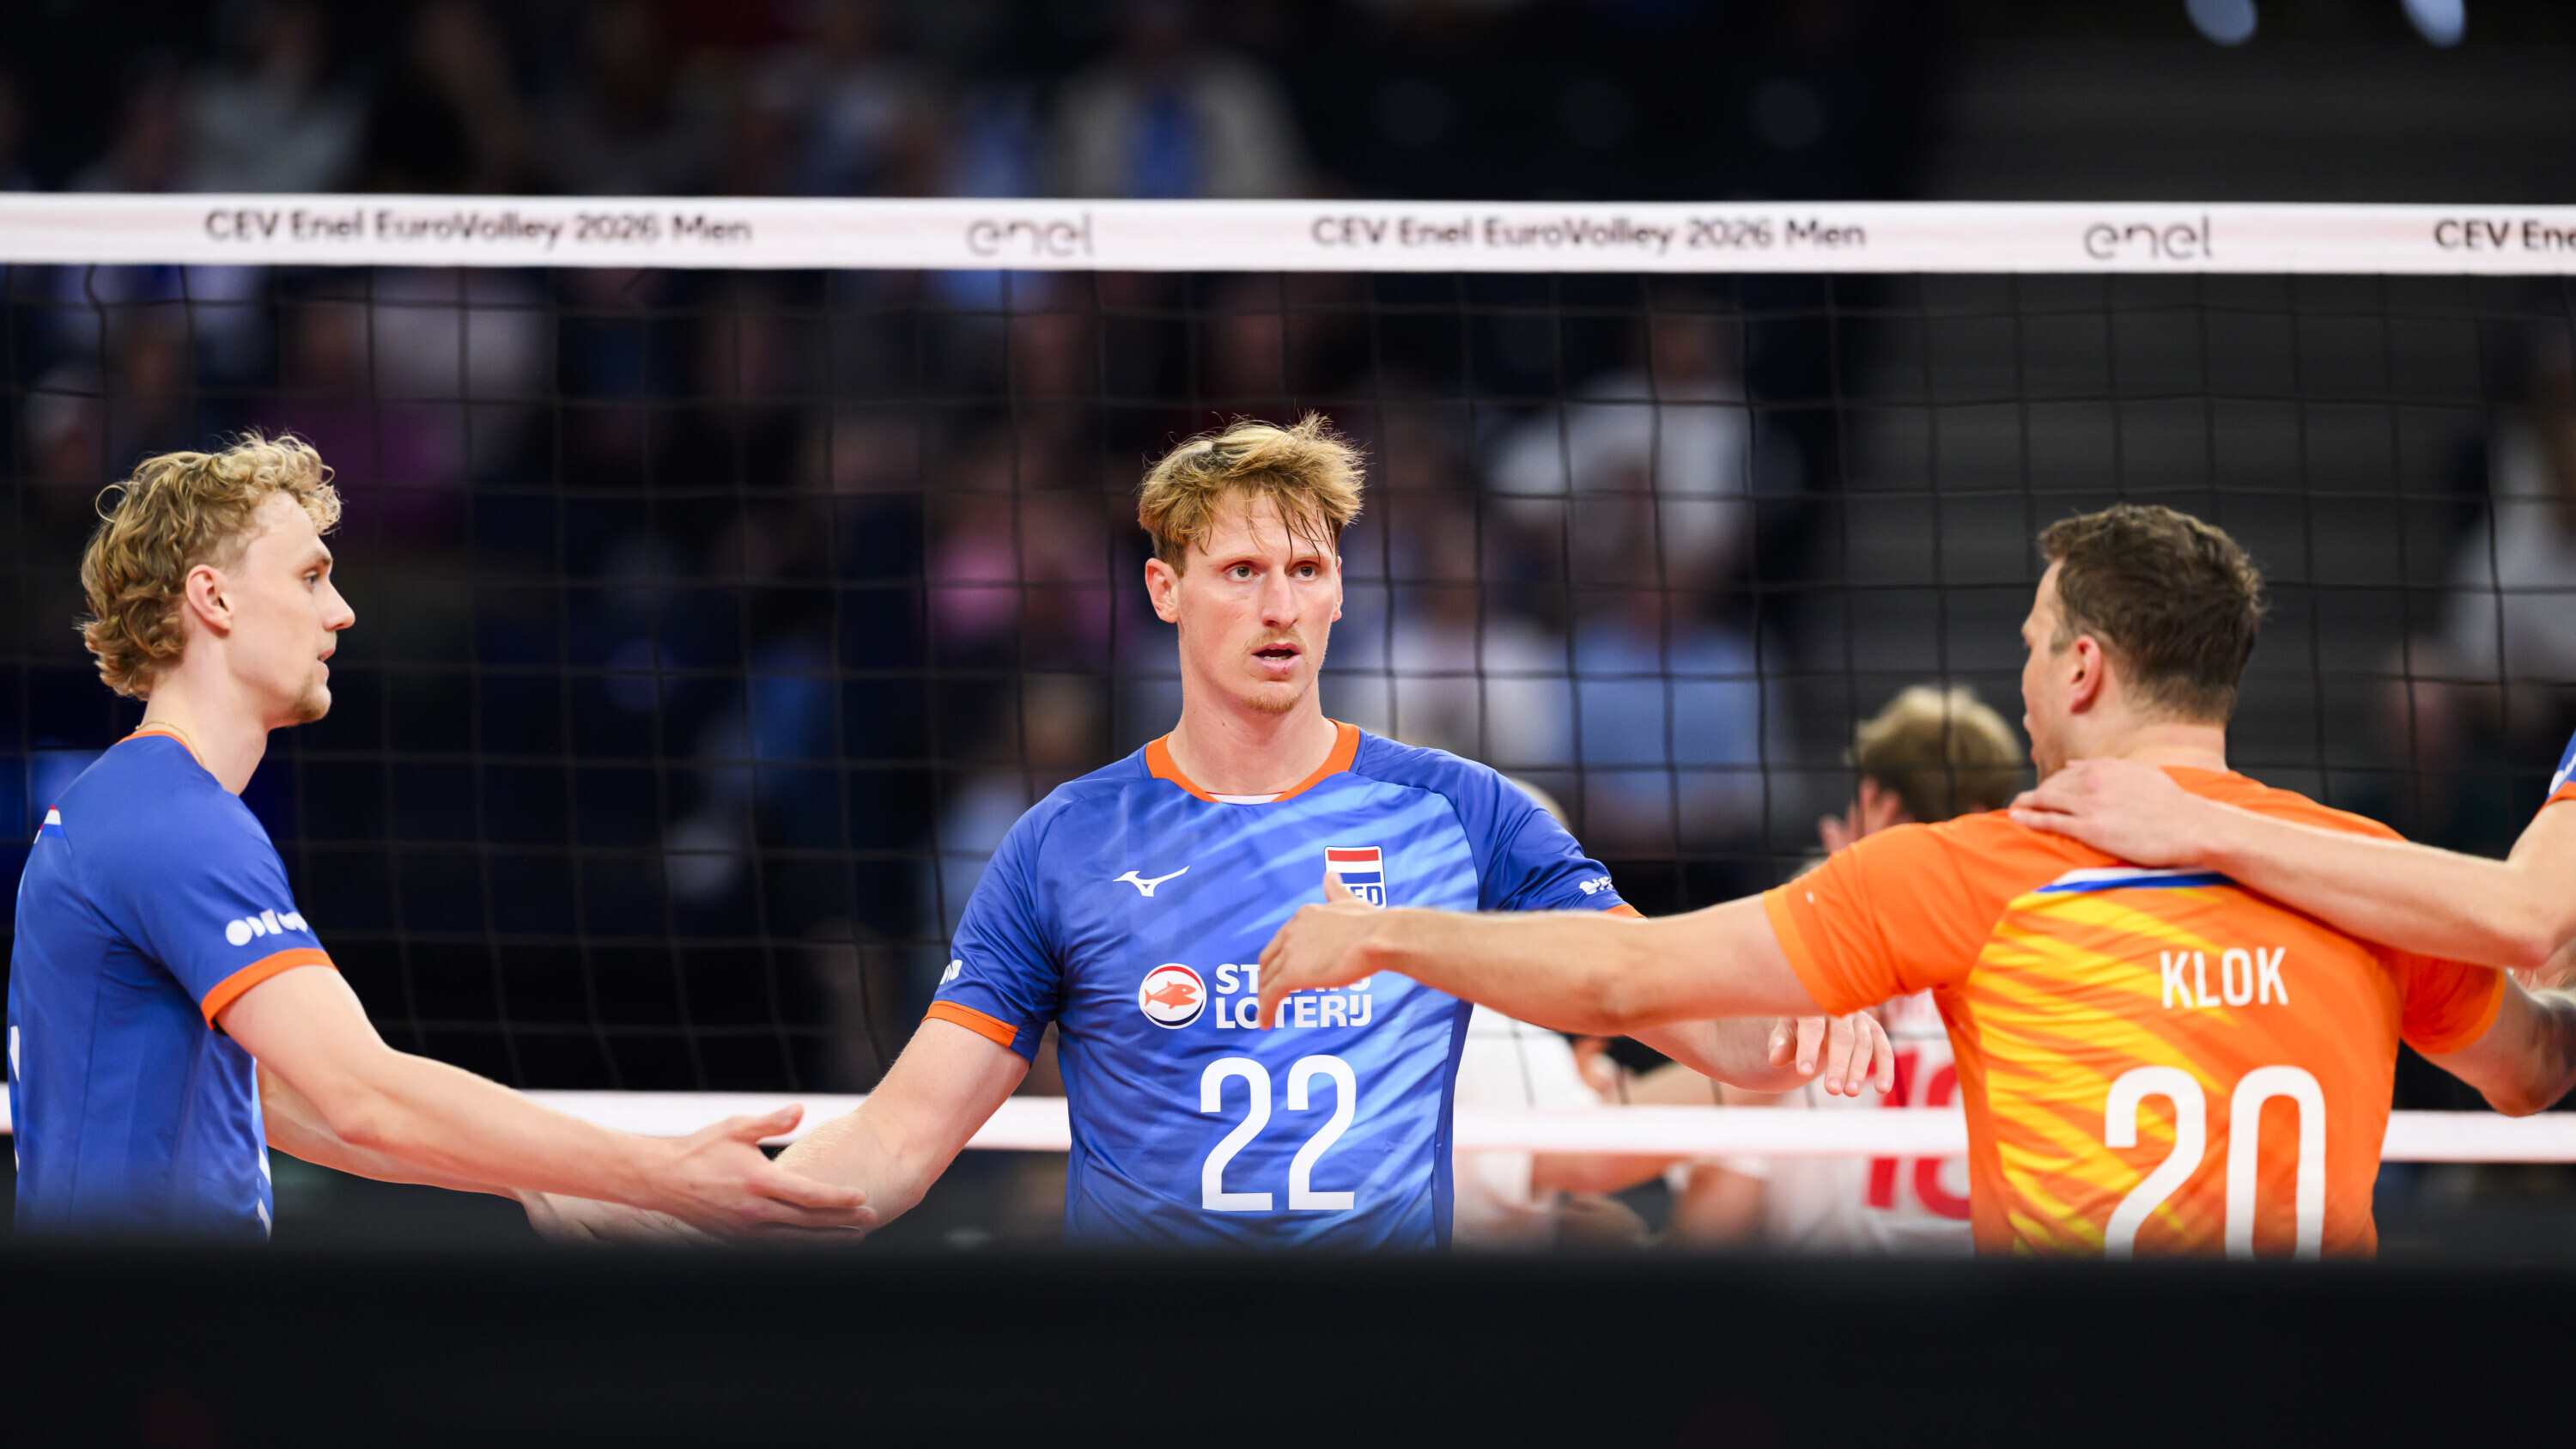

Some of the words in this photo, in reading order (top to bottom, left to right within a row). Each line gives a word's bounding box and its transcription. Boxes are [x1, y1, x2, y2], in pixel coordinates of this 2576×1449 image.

[204, 209, 282, 241] CEV
[289, 209, 366, 240] Enel
[374, 209, 565, 250] EuroVolley
[575, 211, 662, 243] 2026
[671, 213, 753, 242] Men
[966, 214, 1093, 256] enel
[1309, 215, 1388, 247] CEV
[1397, 216, 1474, 247] Enel
[1482, 216, 1676, 255] EuroVolley
[1686, 217, 1775, 249] 2026
[1784, 218, 1868, 248] Men
[2083, 215, 2213, 259] enel
[2432, 217, 2512, 251] CEV
[2160, 947, 2289, 1008] KLOK
[1215, 994, 1372, 1030] LOTERIJ
[1200, 1054, 1357, 1212] 22
[2105, 1065, 2326, 1260] 20
